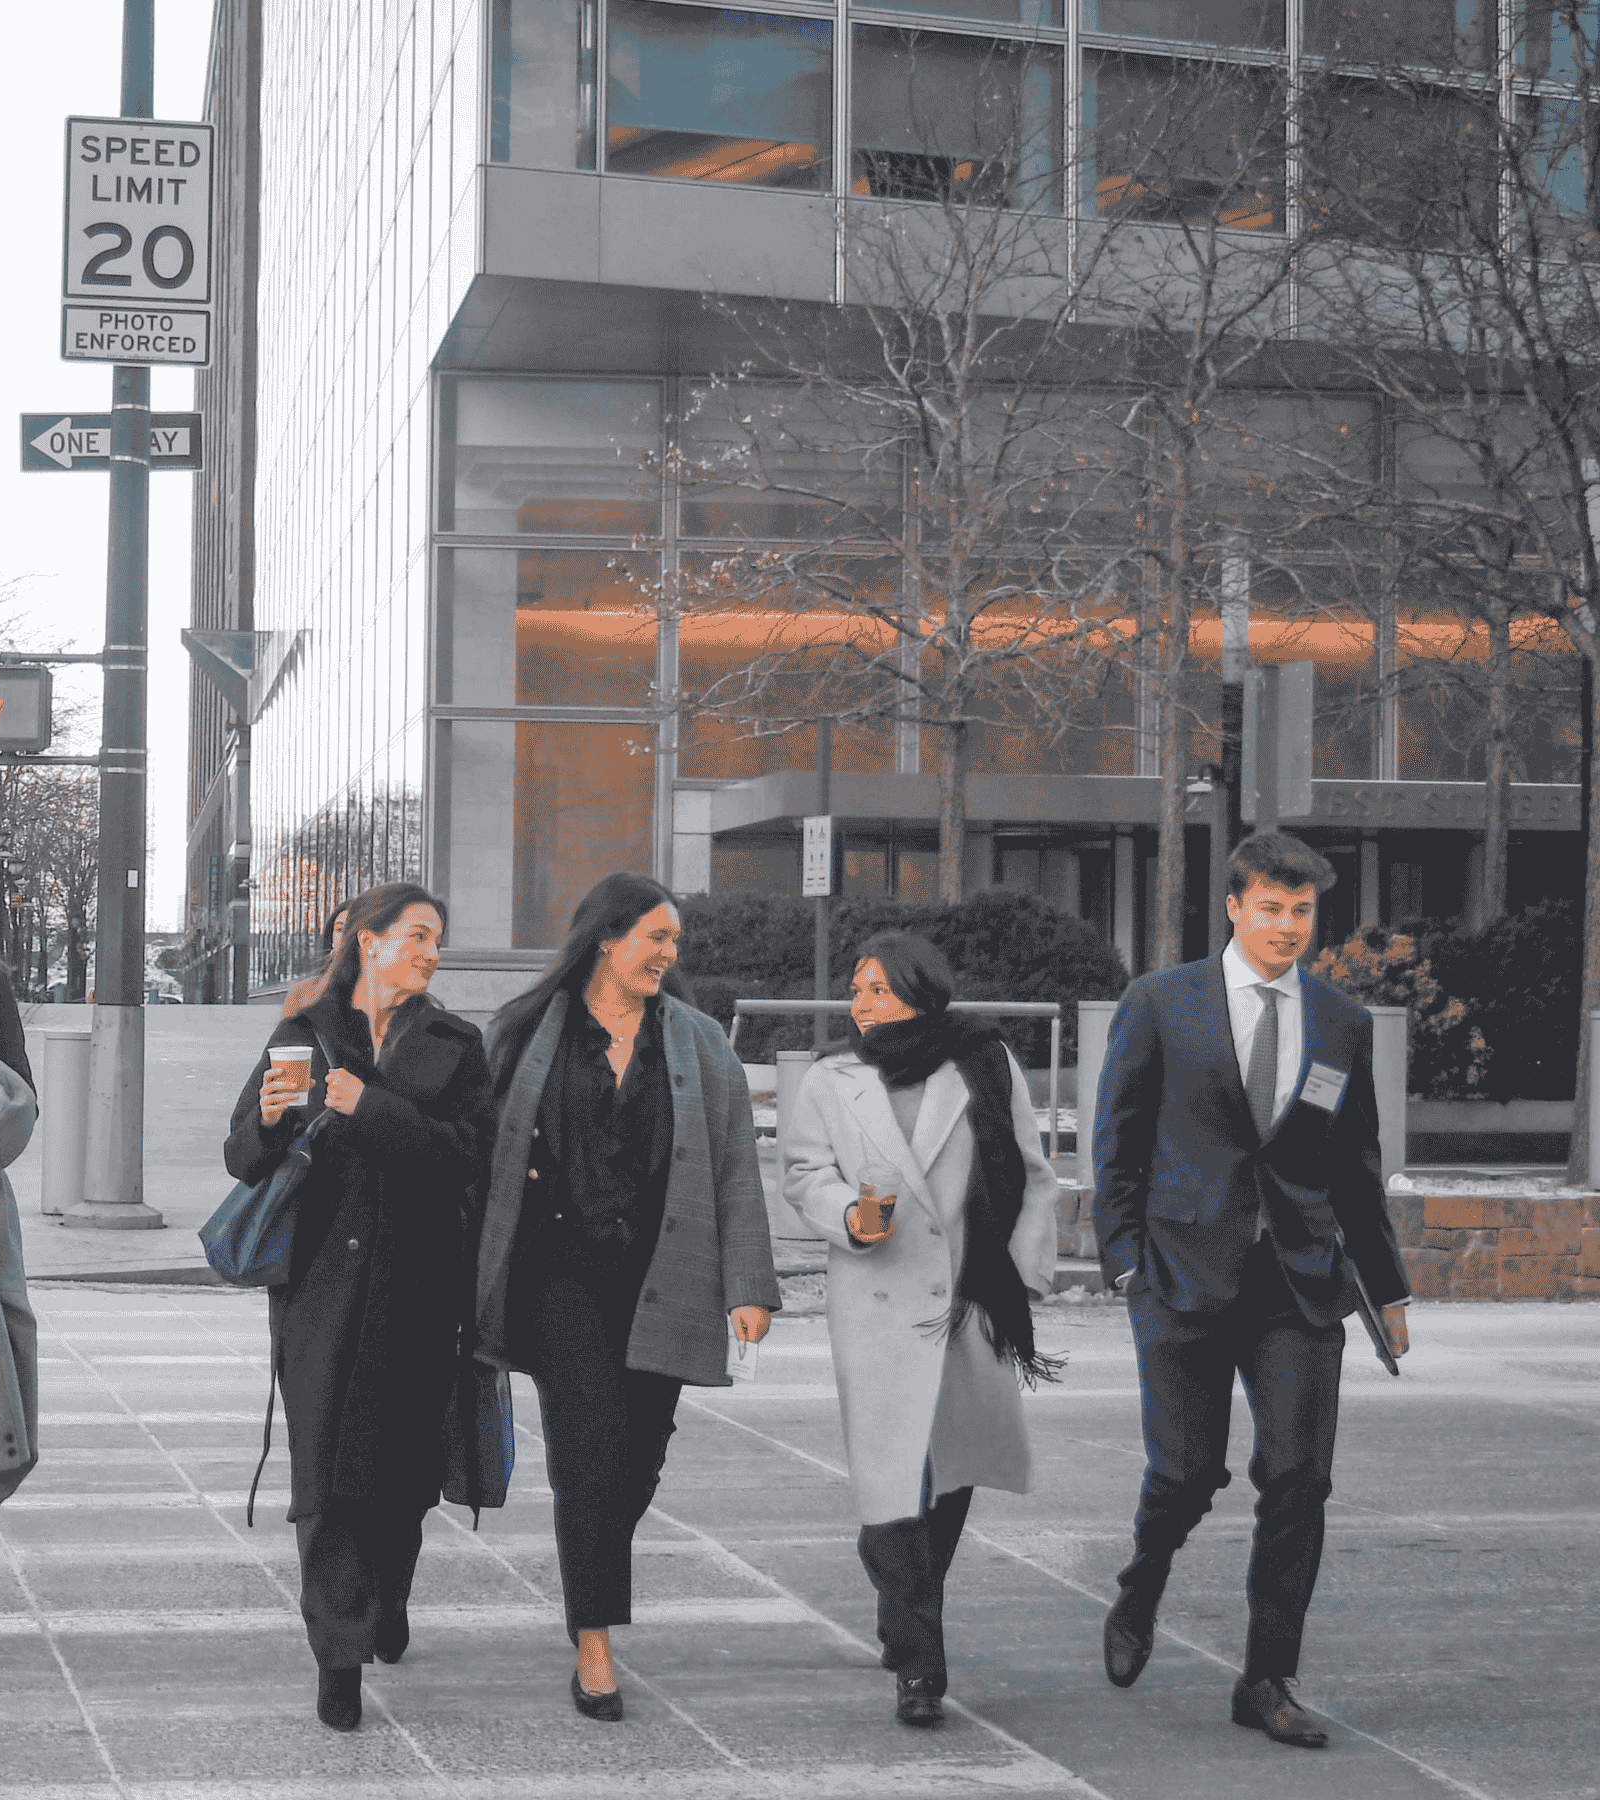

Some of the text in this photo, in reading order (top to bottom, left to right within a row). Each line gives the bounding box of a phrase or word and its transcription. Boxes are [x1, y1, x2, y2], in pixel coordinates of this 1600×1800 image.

[81, 135, 200, 167] SPEED
[92, 174, 187, 205] LIMIT
[81, 221, 195, 290] 20
[99, 312, 174, 332] PHOTO
[75, 332, 197, 354] ENFORCED
[50, 430, 179, 454] ONE AY
